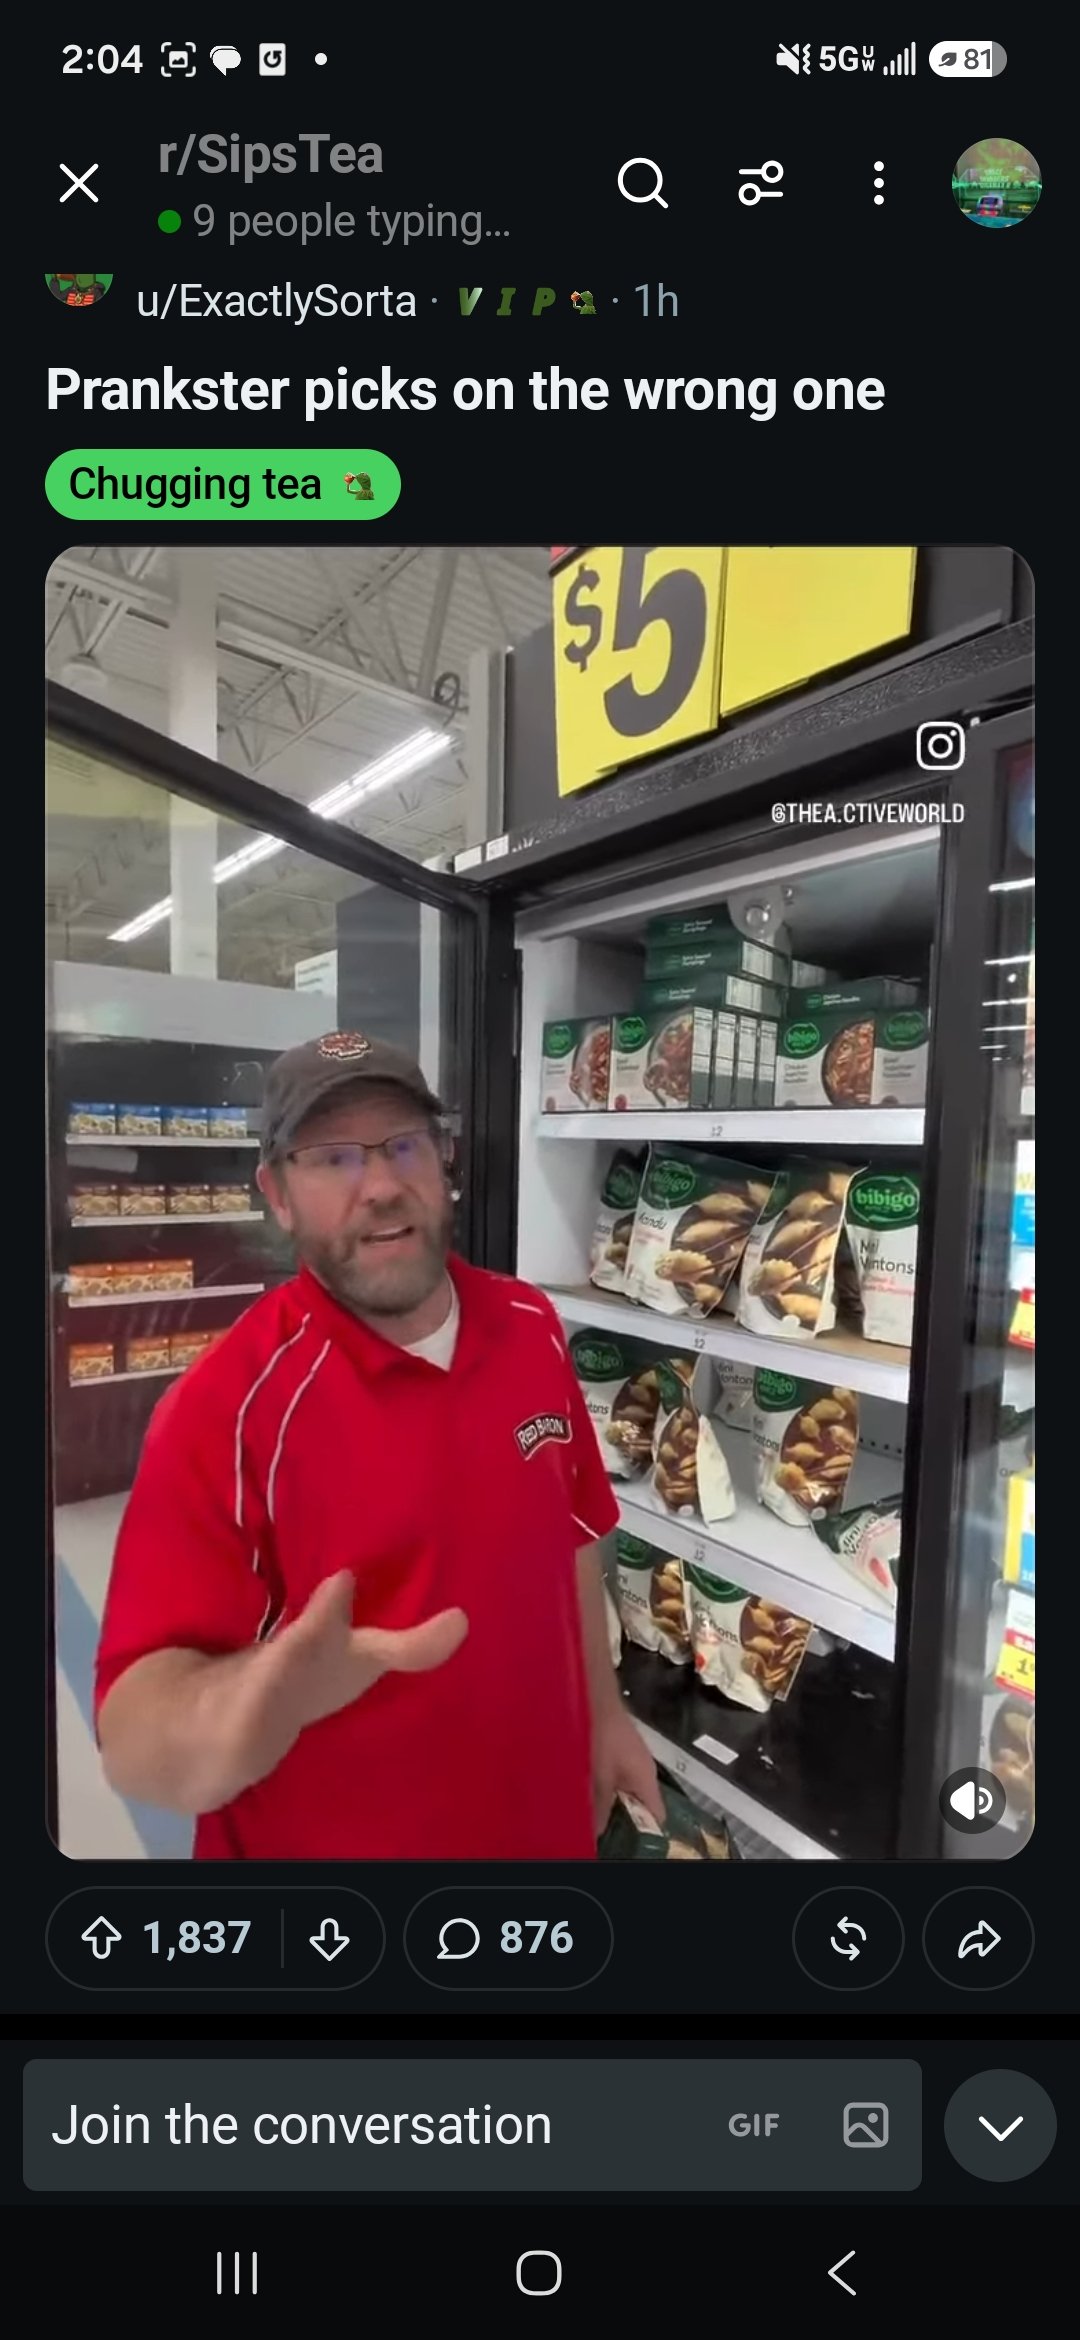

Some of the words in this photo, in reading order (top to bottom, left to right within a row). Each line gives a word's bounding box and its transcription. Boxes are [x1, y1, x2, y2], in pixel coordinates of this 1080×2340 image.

[62, 43, 144, 75] 2:04
[963, 48, 991, 70] 81
[159, 132, 384, 184] r/SipsTea
[193, 203, 215, 237] 9
[229, 201, 356, 246] people
[137, 281, 417, 319] u/ExactlySorta
[635, 282, 678, 317] 1h
[47, 365, 291, 411] Prankster
[305, 365, 437, 422] picks
[452, 377, 514, 411] on
[528, 365, 610, 411] the
[623, 377, 777, 422] wrong
[792, 377, 886, 411] one
[69, 465, 251, 509] Chugging
[261, 468, 322, 500] tea
[855, 1188, 916, 1213] bibigo
[517, 1424, 538, 1451] RED
[143, 1920, 252, 1962] 1,837
[500, 1920, 574, 1954] 876
[51, 2103, 150, 2145] Join
[164, 2102, 238, 2145] the
[253, 2103, 551, 2145] conversation
[728, 2113, 780, 2137] GIF
